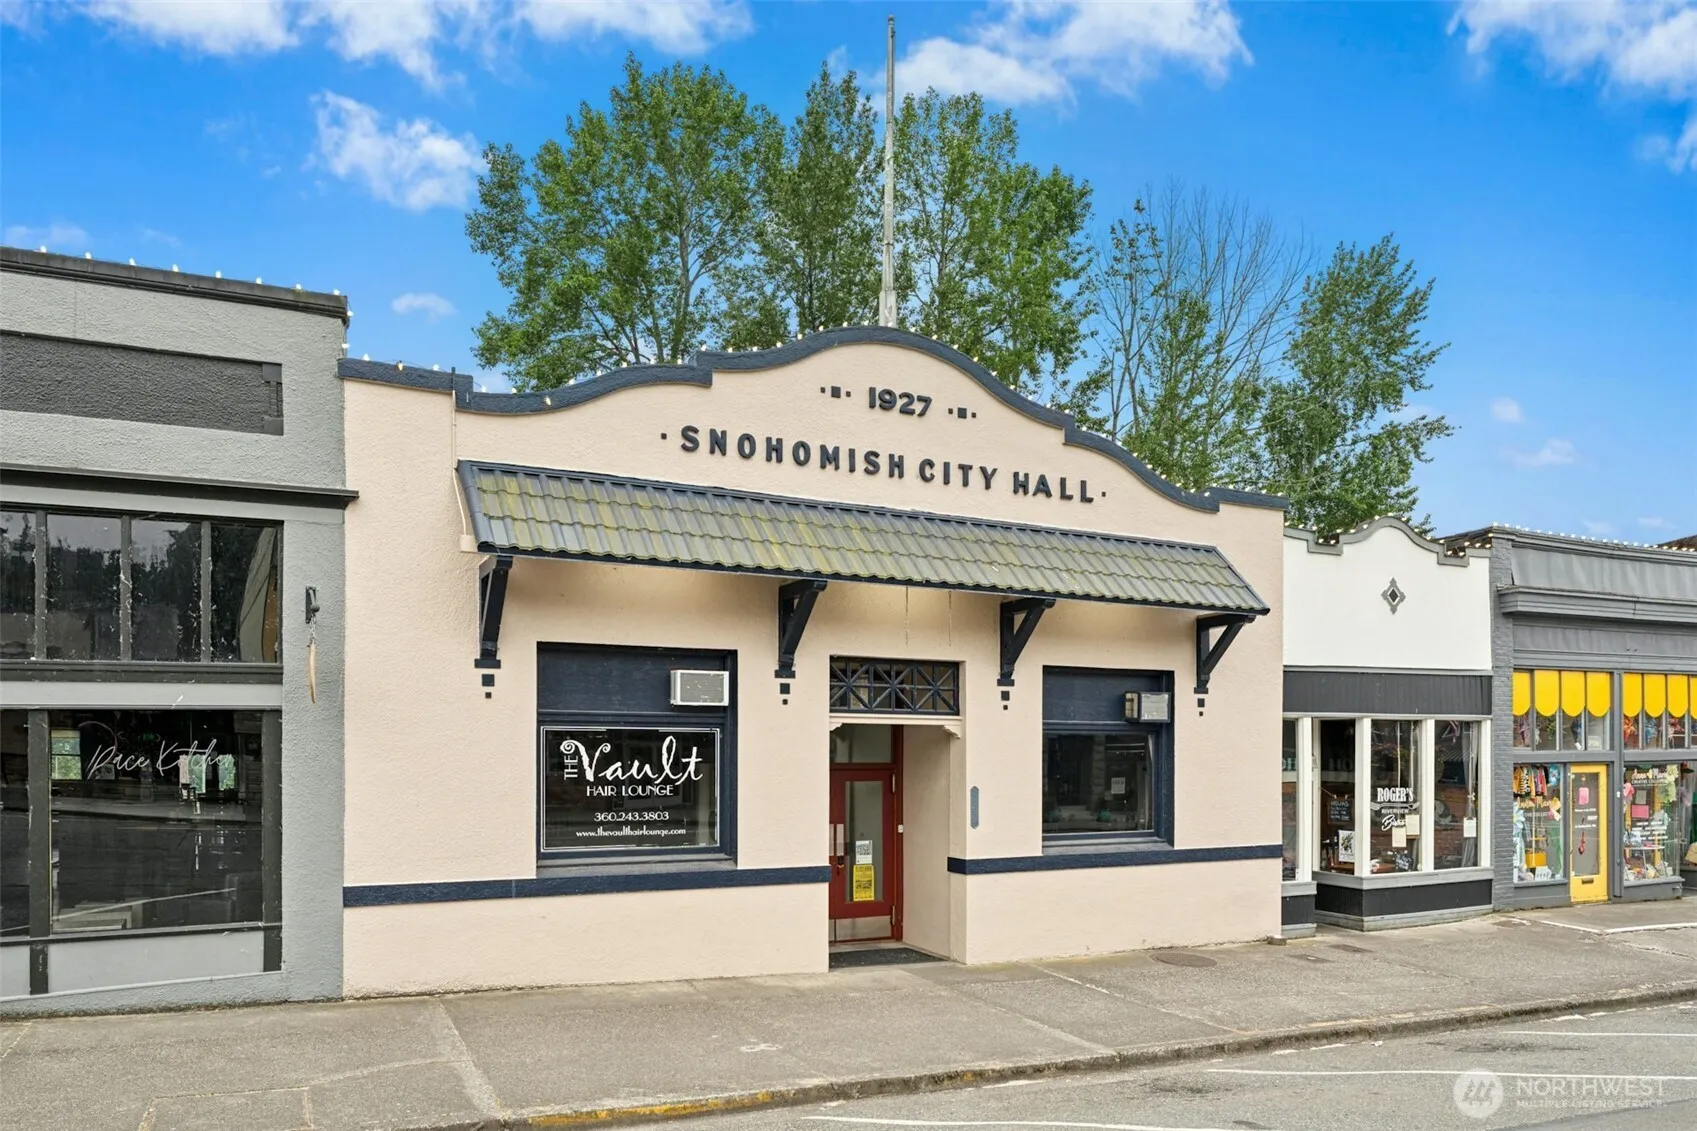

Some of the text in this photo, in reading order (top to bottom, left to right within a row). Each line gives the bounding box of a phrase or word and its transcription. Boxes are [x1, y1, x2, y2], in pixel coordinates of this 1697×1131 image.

[868, 386, 933, 416] 1927
[681, 425, 1095, 504] SNOHOMISH CITY HALL
[560, 735, 703, 785] Vault
[564, 755, 578, 780] THE
[586, 785, 674, 797] HAIR LOUNGE
[1377, 788, 1413, 802] ROGER'S
[594, 811, 669, 822] 360.243.3803
[576, 825, 686, 837] www.thevaulthairlounge.com
